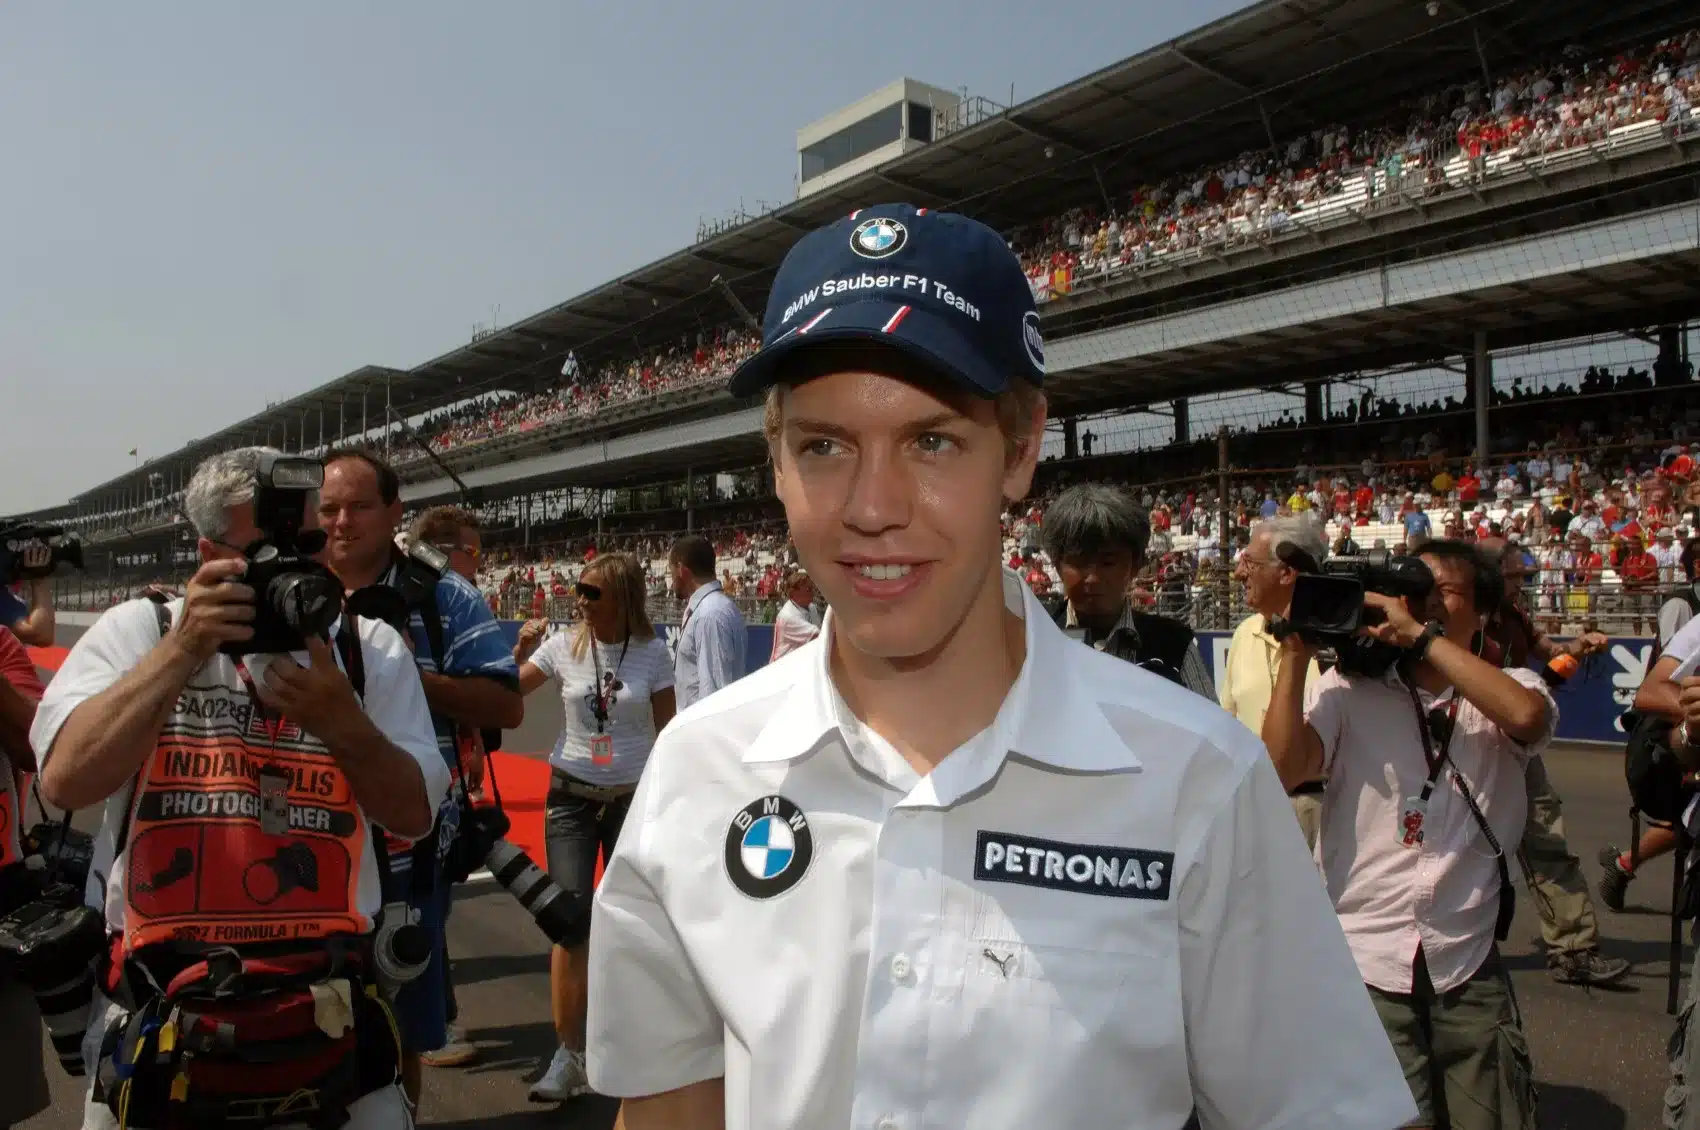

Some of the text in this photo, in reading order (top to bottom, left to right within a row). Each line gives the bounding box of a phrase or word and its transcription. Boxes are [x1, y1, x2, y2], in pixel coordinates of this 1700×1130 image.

[856, 218, 904, 233] BMW
[781, 273, 981, 324] BMW Sauber F1 Team
[164, 751, 336, 796] INDIANOLIS
[161, 792, 331, 831] PHOTOGHER
[734, 797, 807, 832] BMW
[984, 841, 1164, 890] PETRONAS
[214, 924, 287, 941] FORMULA
